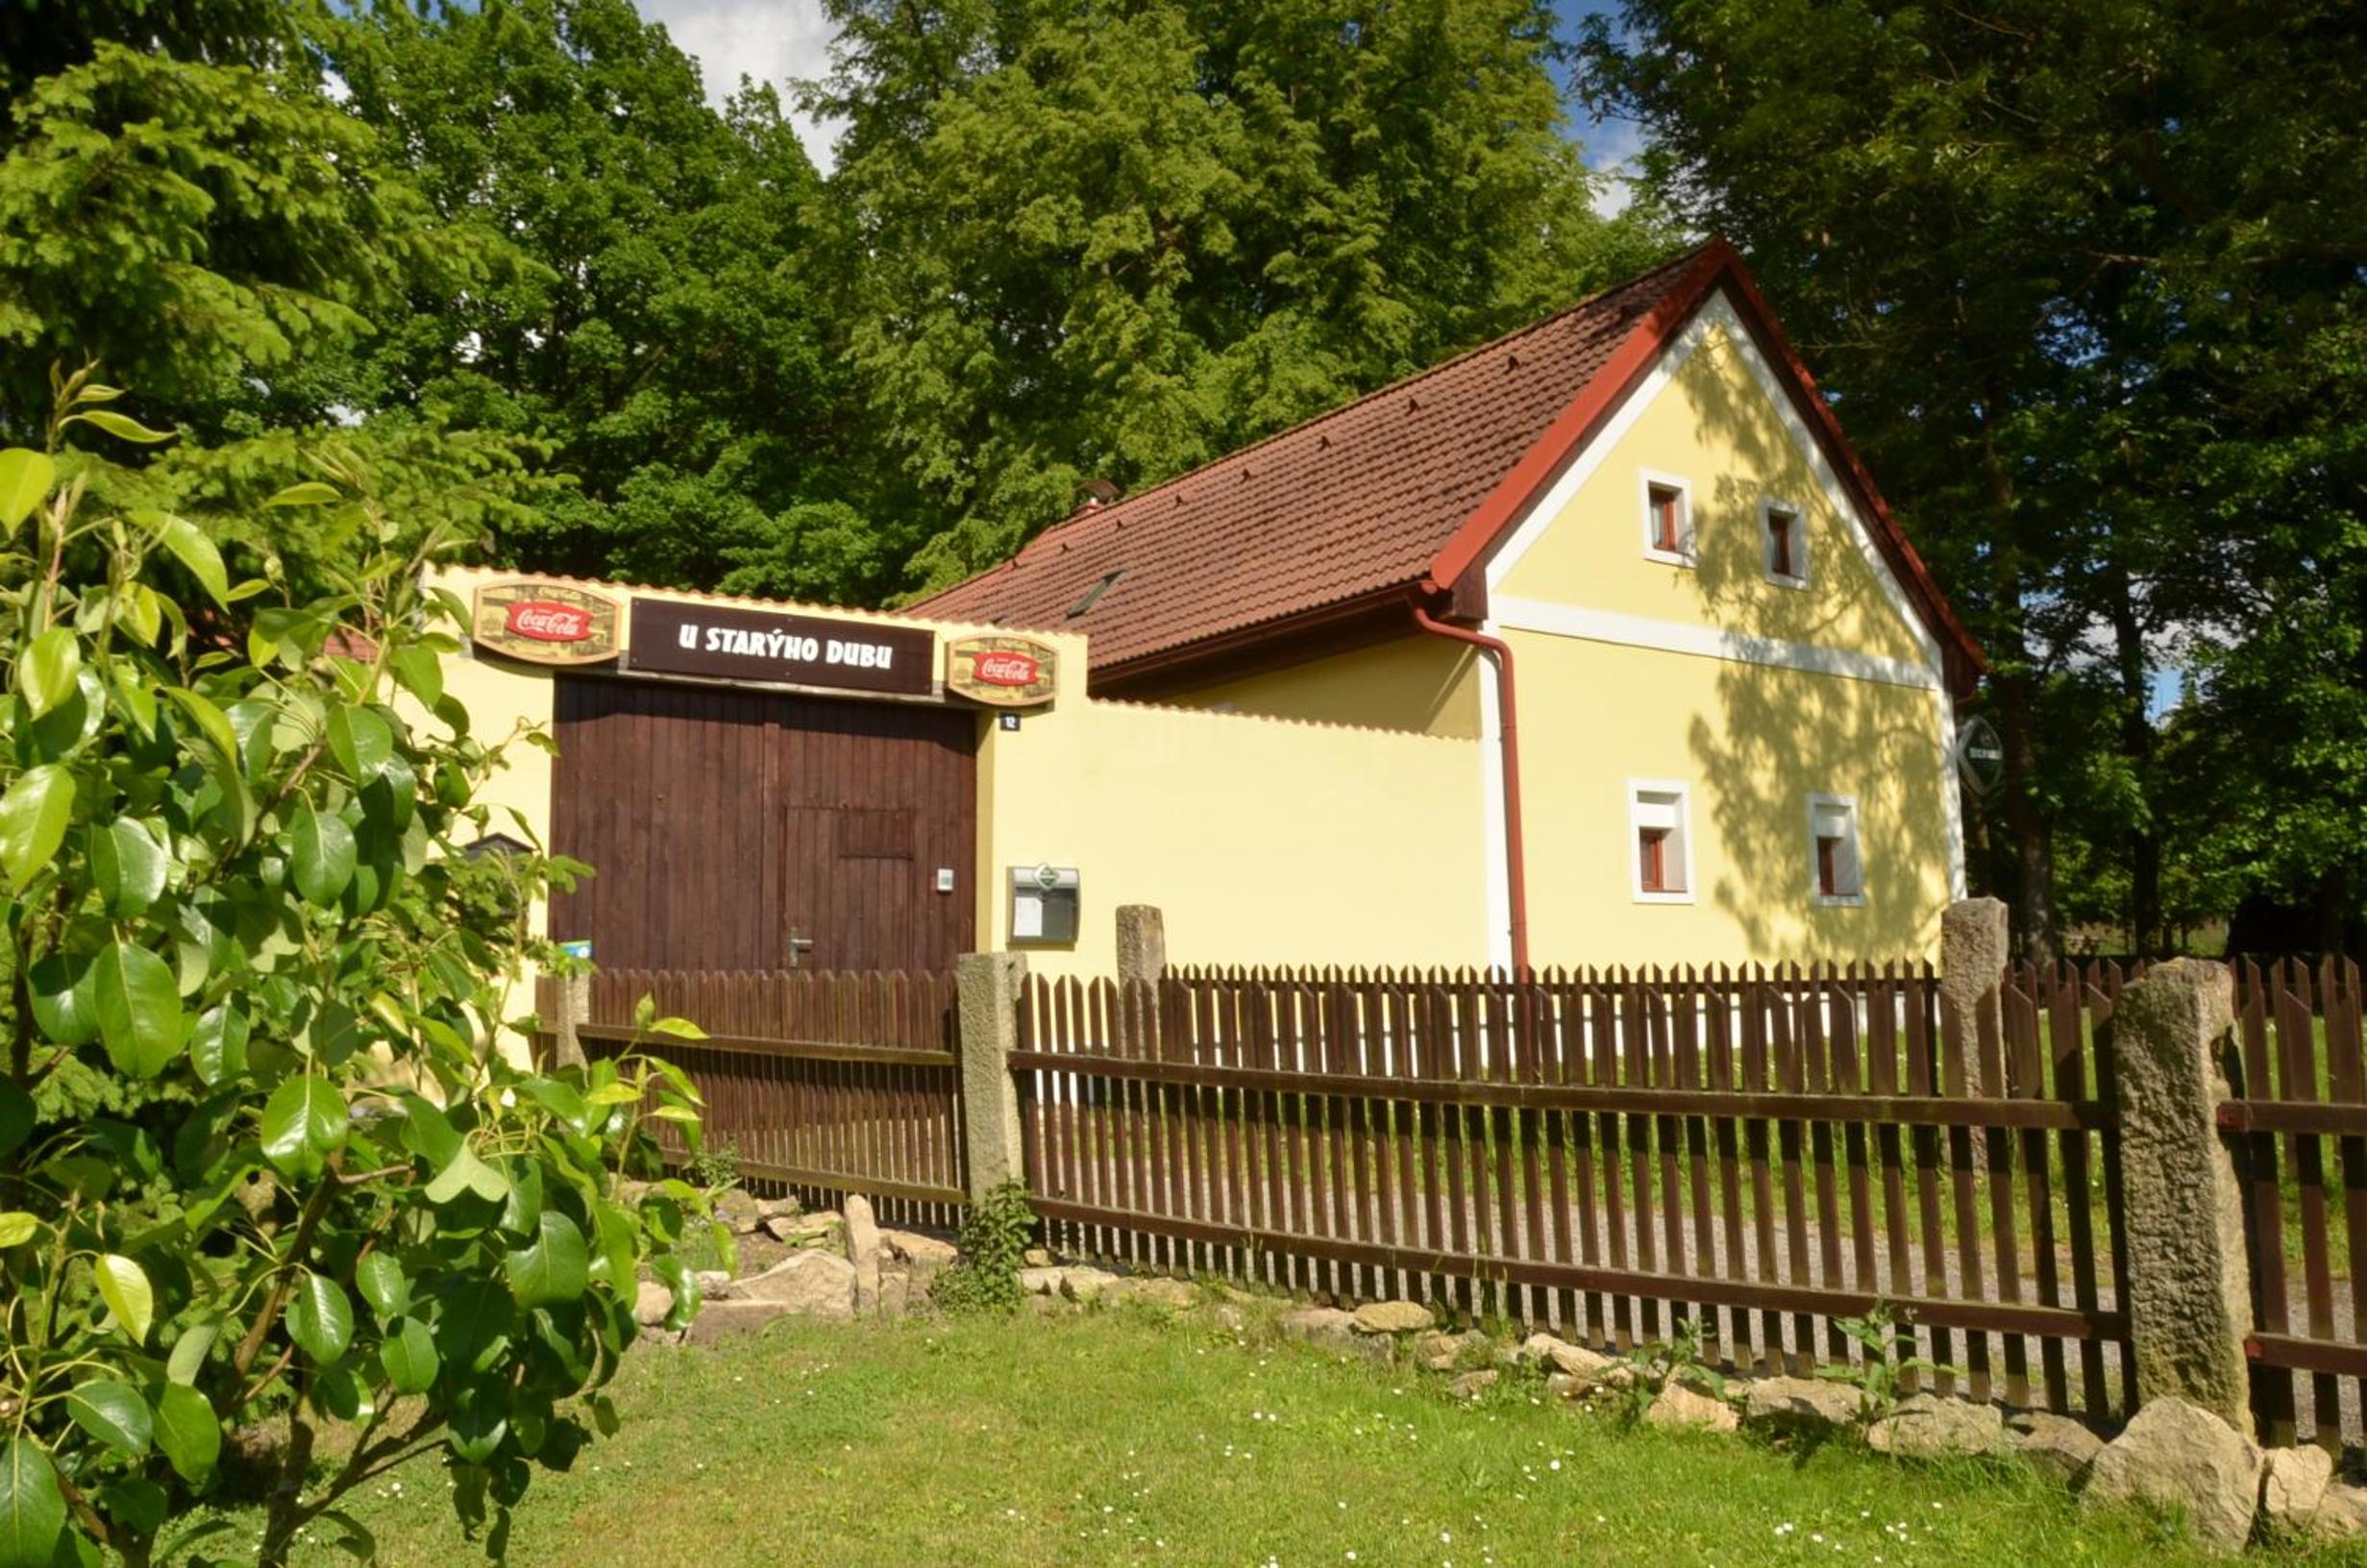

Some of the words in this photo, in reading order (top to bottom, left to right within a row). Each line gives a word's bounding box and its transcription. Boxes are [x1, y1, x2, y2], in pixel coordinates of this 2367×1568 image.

[678, 625, 699, 649] U
[704, 627, 819, 662] STARÝHO
[825, 639, 893, 670] DUBU
